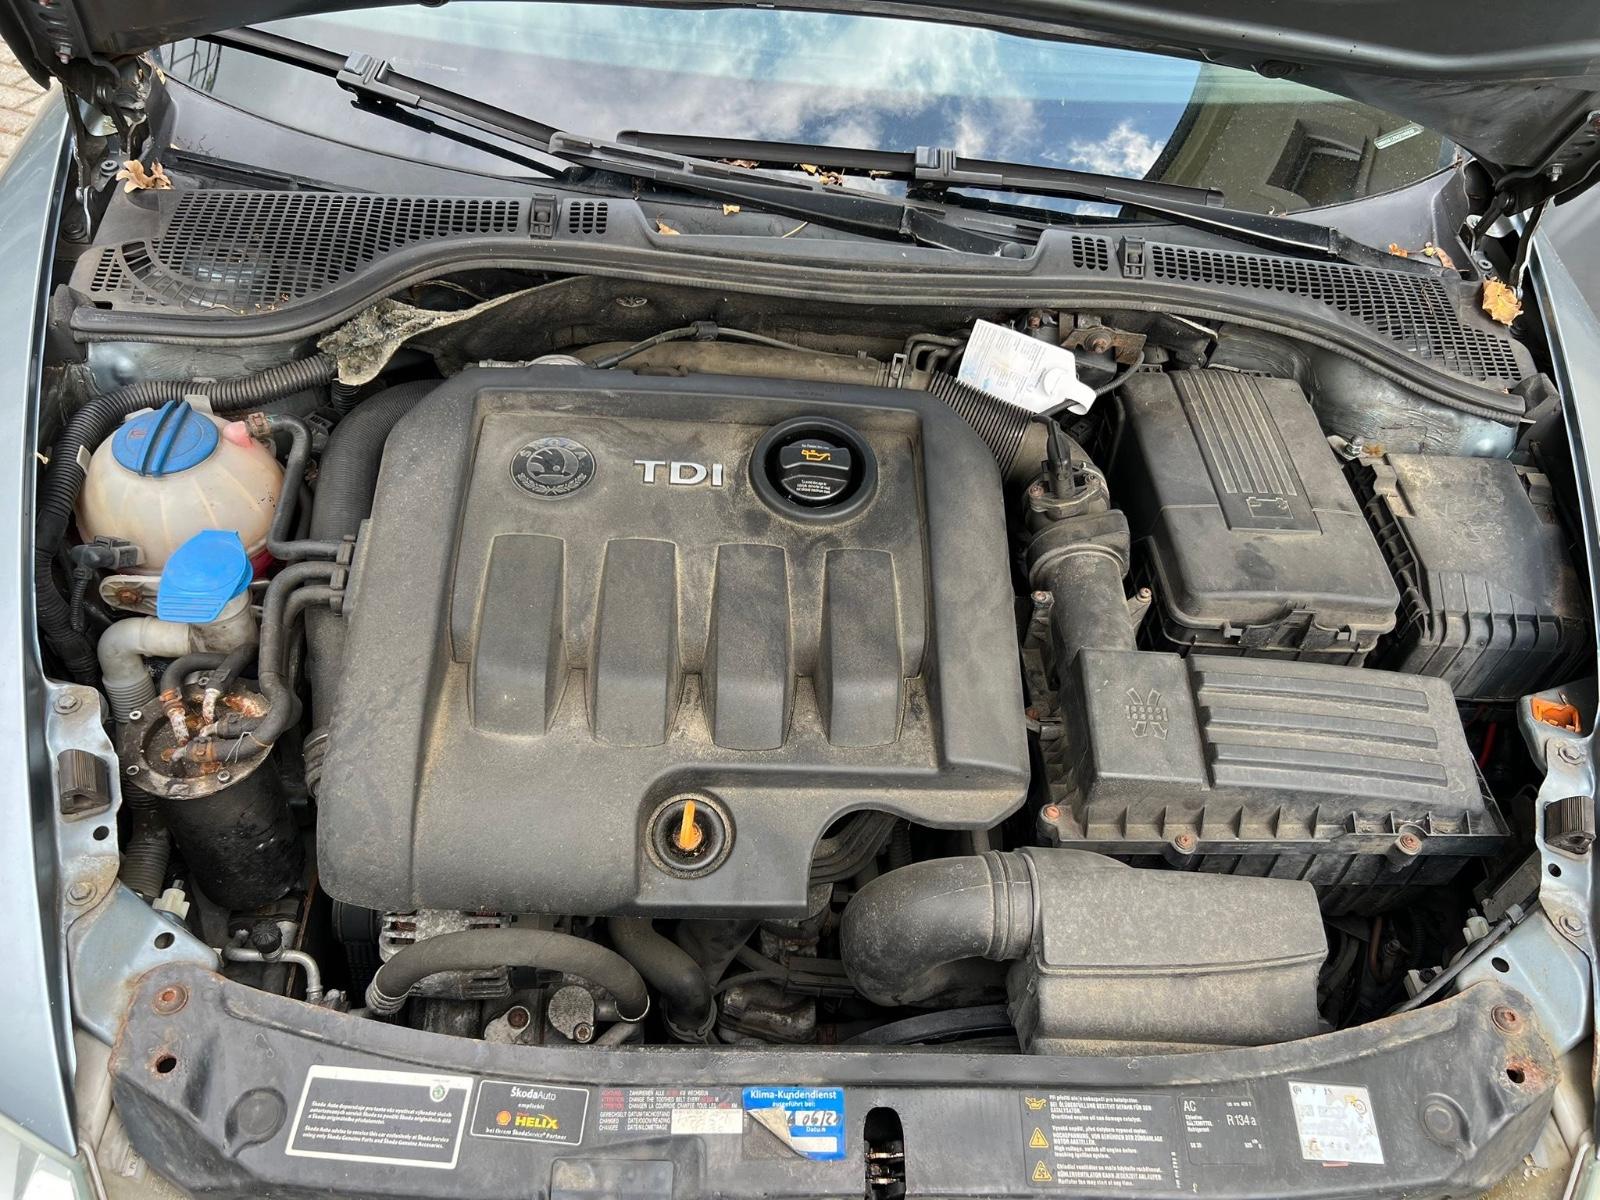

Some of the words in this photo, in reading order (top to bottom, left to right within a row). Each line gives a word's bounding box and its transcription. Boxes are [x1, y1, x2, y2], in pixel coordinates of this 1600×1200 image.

[634, 460, 723, 486] TDI
[511, 1086, 556, 1100] ŠkodaAuto
[750, 1090, 836, 1099] Klima-Kundendienst
[1184, 1100, 1196, 1112] AC
[515, 1115, 559, 1129] HELIX
